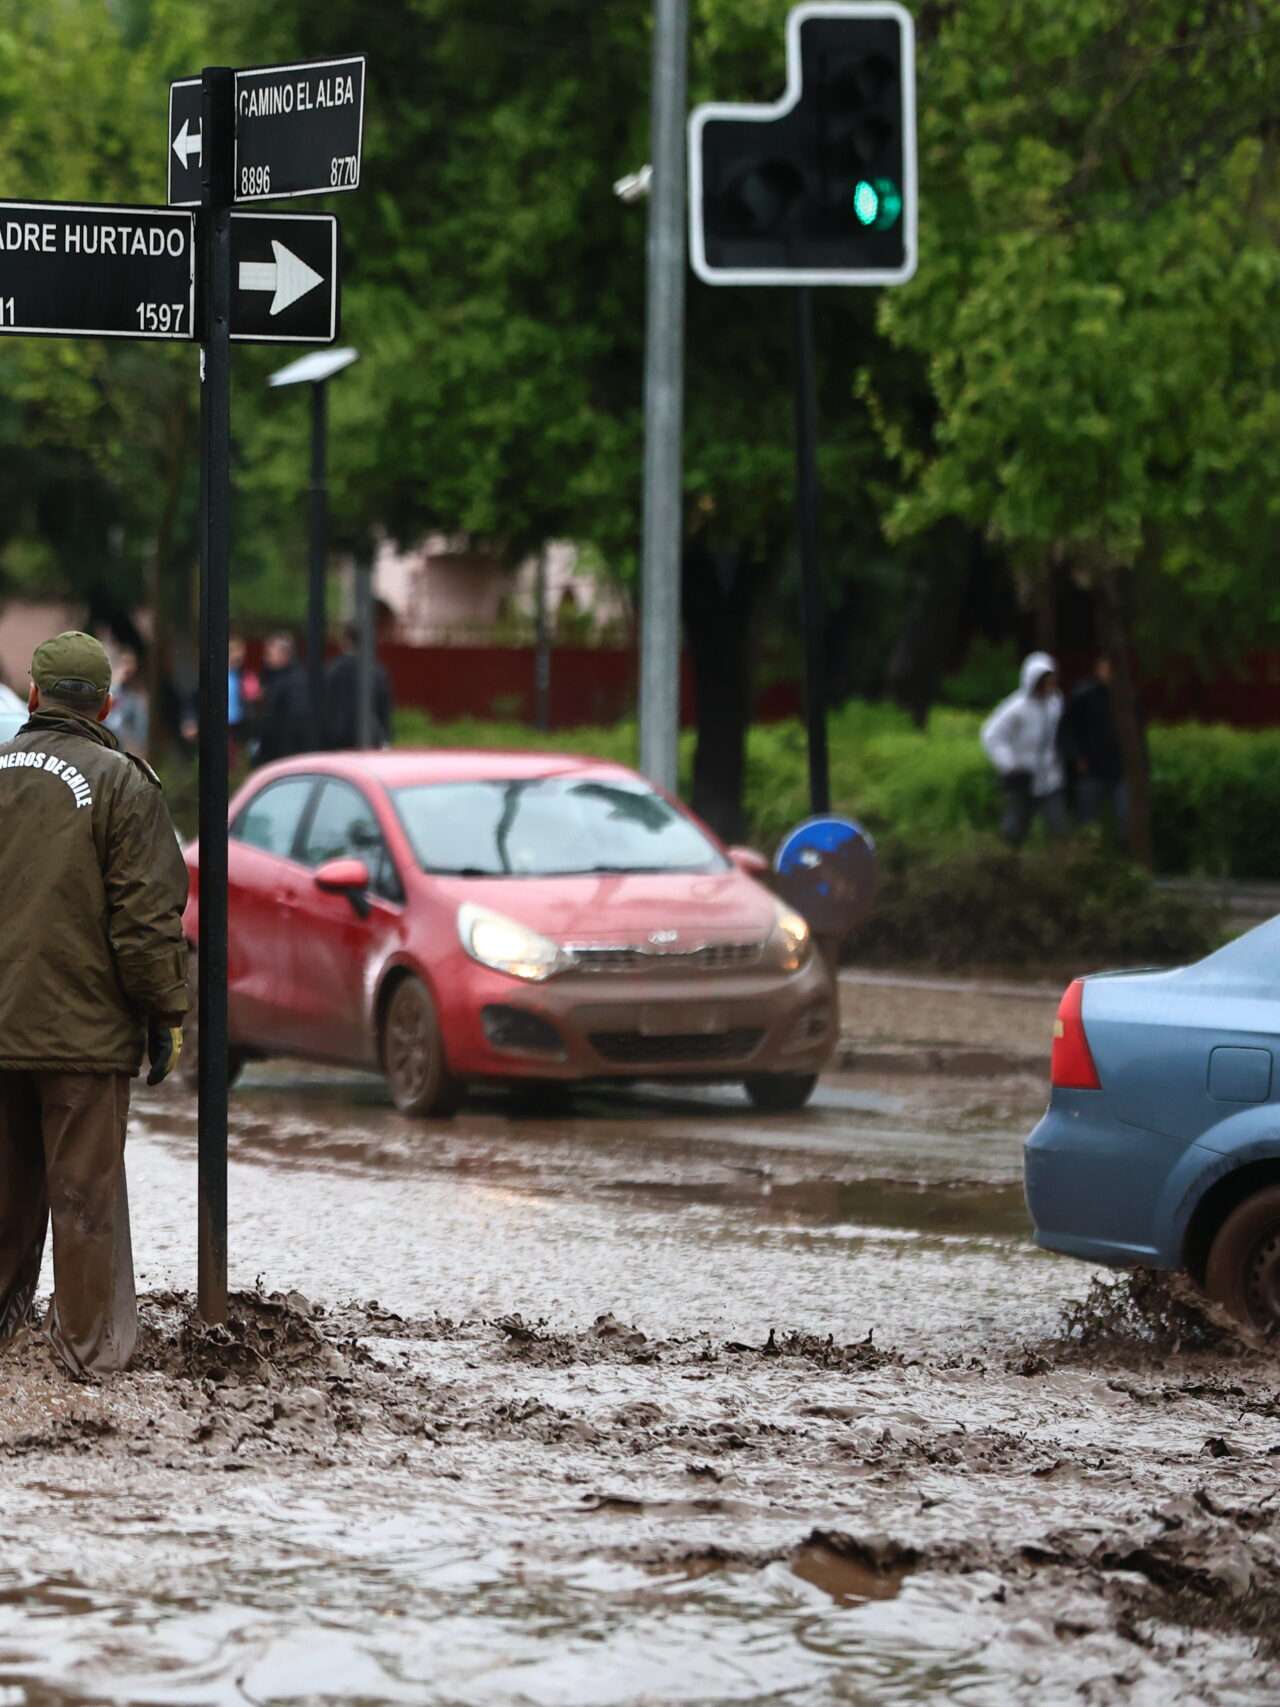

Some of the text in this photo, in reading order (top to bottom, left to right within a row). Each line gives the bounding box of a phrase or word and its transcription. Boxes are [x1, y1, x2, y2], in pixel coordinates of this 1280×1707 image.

[240, 76, 354, 117] CAMINO EL ALBA
[241, 165, 271, 195] 8896
[330, 155, 357, 186] 8770
[65, 224, 185, 257] HURTADO
[136, 302, 184, 332] 1597
[43, 755, 67, 775] DE
[60, 766, 93, 809] CHILE
